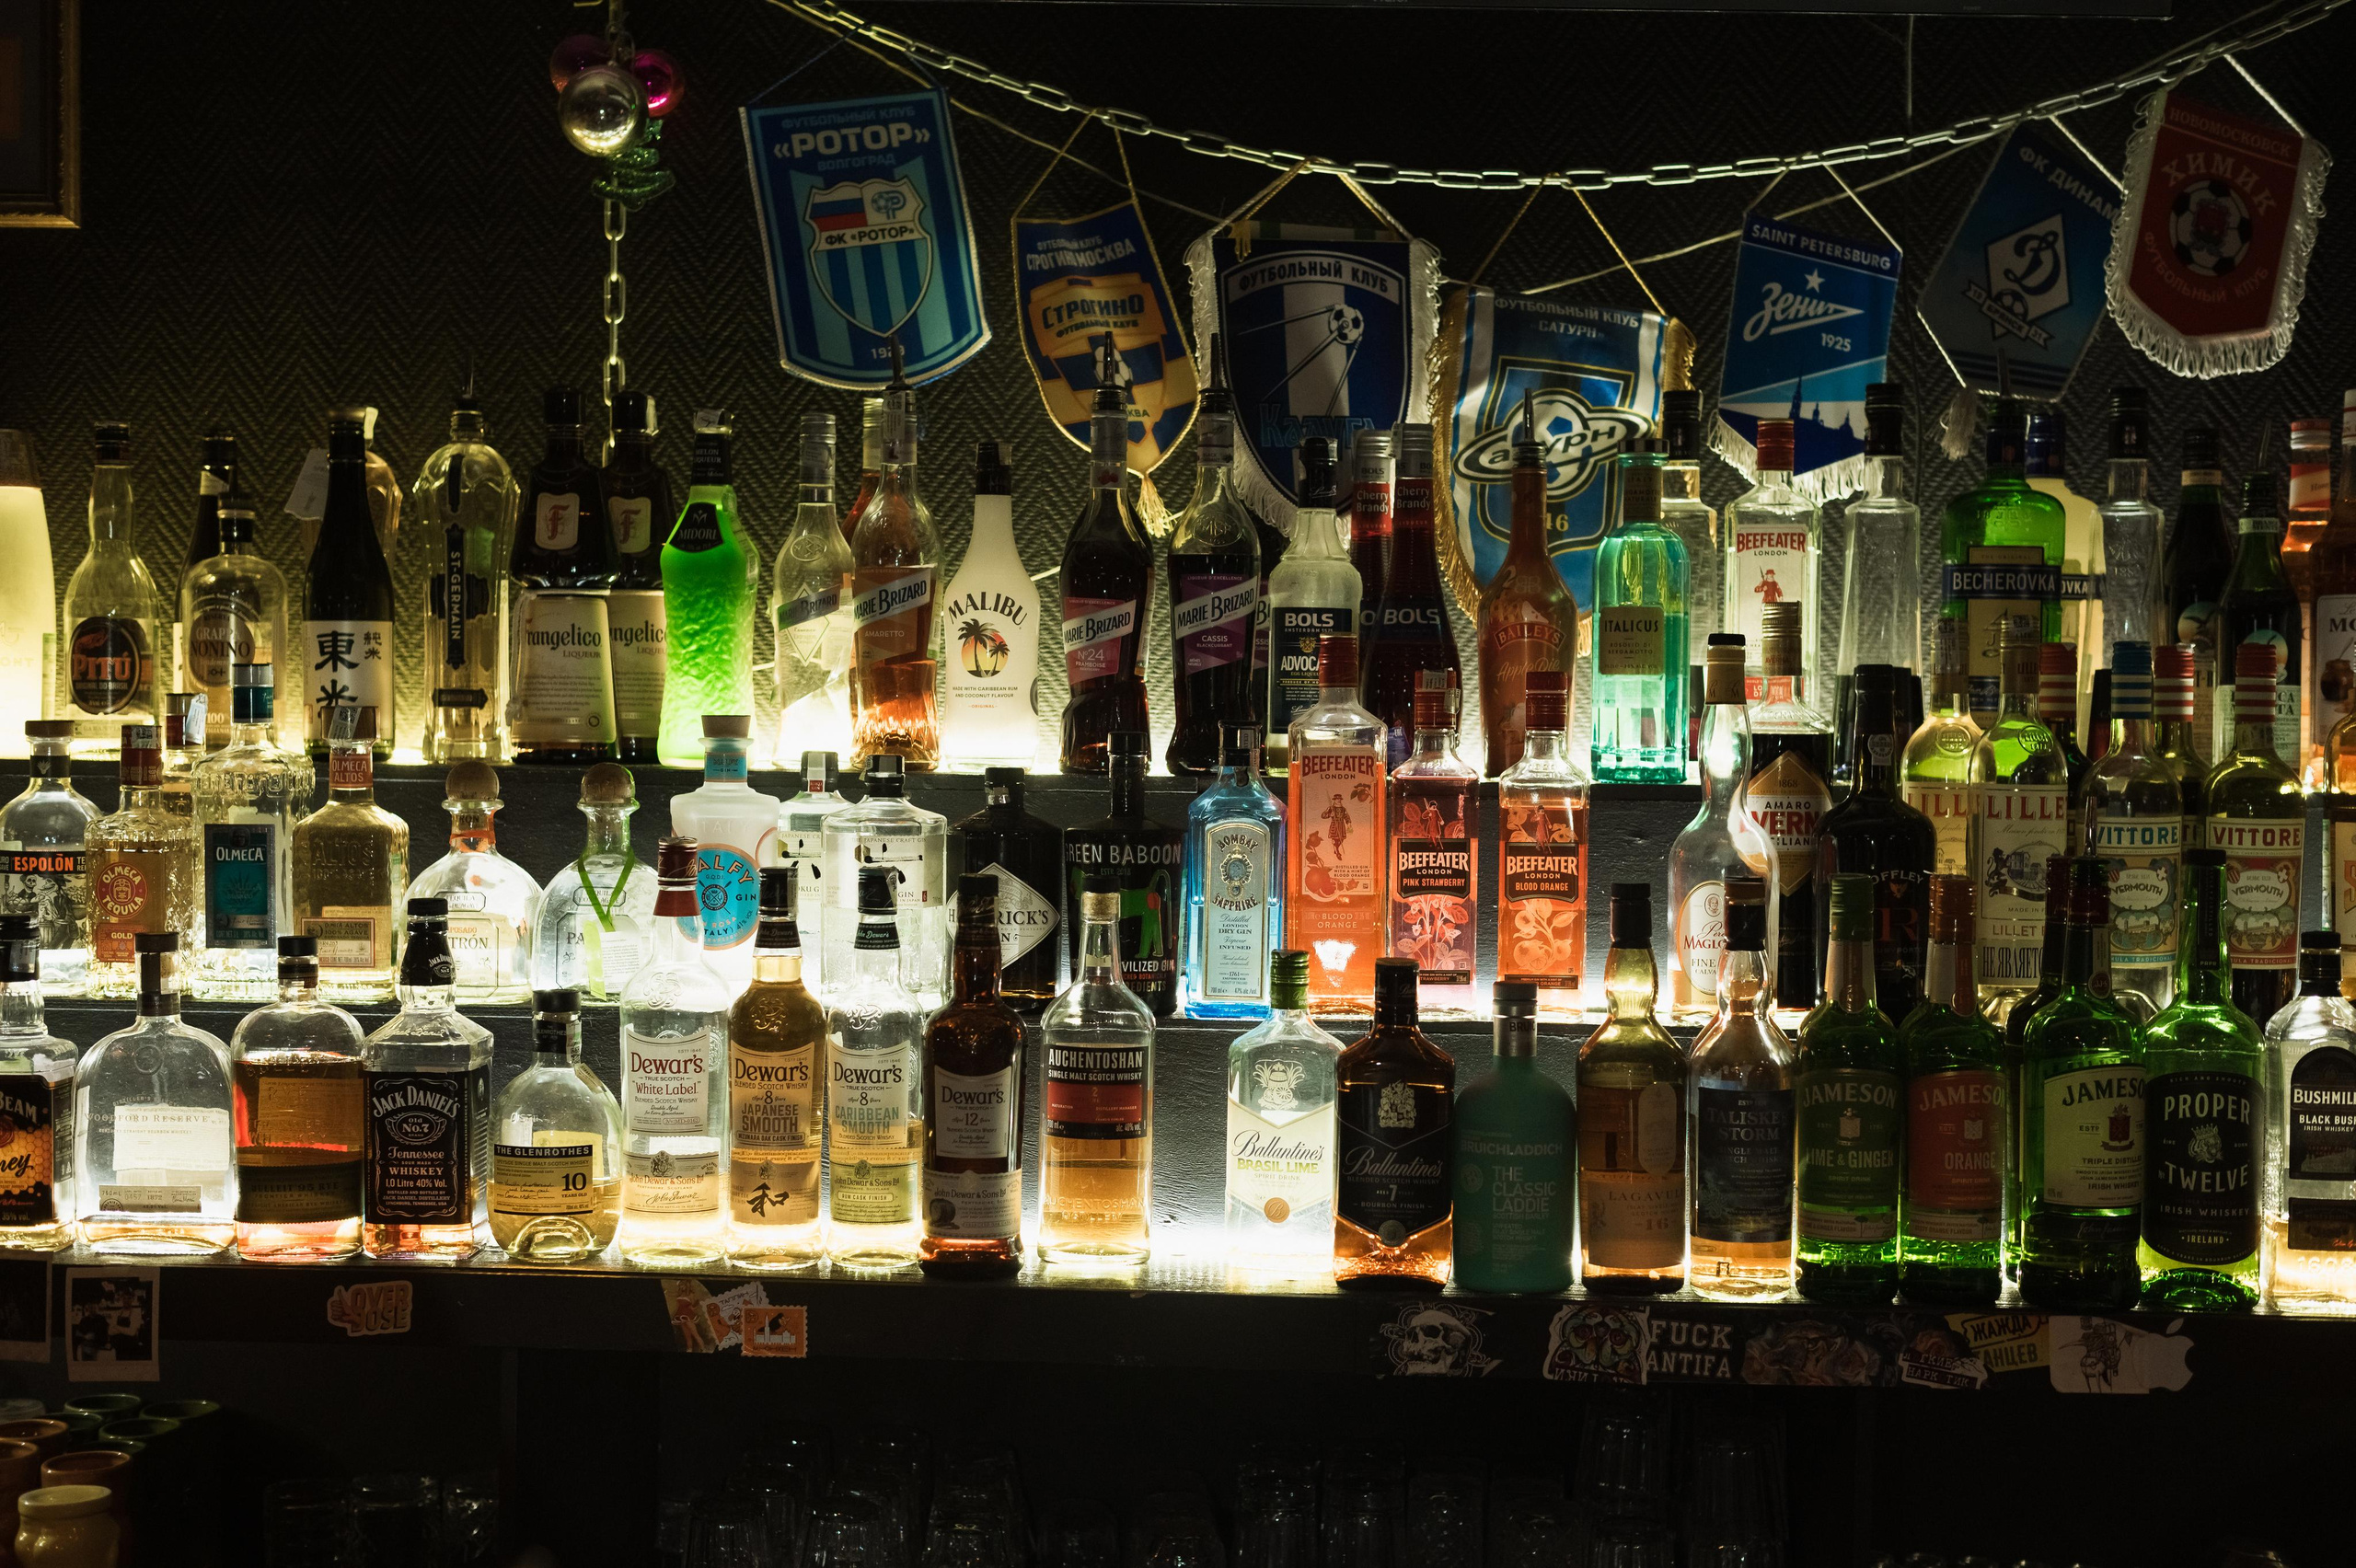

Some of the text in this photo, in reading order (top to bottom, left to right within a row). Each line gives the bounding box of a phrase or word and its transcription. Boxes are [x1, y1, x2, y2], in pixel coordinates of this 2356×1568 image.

[780, 105, 916, 129] ФУТБОЛЬНЫЙ КЛУБ
[773, 122, 931, 159] «РОТОР»
[2169, 108, 2291, 156] НОВОМОСКОВСК
[817, 152, 896, 172] ВОЛГОГРАД
[2018, 145, 2119, 223] ФК ДИНАМ
[2161, 151, 2276, 216] ХИМИК
[825, 225, 916, 246] ФК «РОТОР»
[1750, 222, 1894, 273] SAINT PETERSBURG
[1239, 259, 1390, 294] ФУТБОЛЬНЫЙ КЛУБ
[2143, 231, 2269, 303] ФУТБОЛЬНЫЙ КЛУБ
[1041, 294, 1144, 330] СТРОГИНО
[1494, 296, 1640, 329] ФУТБОЛЬНЫЙ КЛУБ
[1820, 332, 1852, 352] 1925
[1360, 467, 1385, 476] BOLS
[1356, 490, 1390, 504] Cherry
[1396, 485, 1430, 500] Cherry
[1356, 502, 1390, 514] Brandy
[1396, 497, 1431, 511] Brandy
[676, 526, 717, 540] MIDORI
[1737, 532, 1807, 553] BEEFEATER
[1952, 571, 2056, 592] BECHEROVKA
[450, 550, 461, 640] ST-GERMAIN
[853, 580, 928, 621] MARIE BRIZARD
[948, 591, 1028, 626] MALIBU
[1176, 586, 1255, 630] MARIE BRIZARD
[1382, 607, 1441, 626] BOLS
[1085, 611, 1132, 642] BRIZARD
[1284, 612, 1334, 628] BOLS
[1603, 619, 1659, 633] ITALICUS
[864, 629, 905, 639] AMARETTO
[1200, 634, 1230, 643] CASSIS
[1498, 621, 1563, 643] BAILEYS
[190, 642, 251, 659] NONINO
[1496, 663, 1534, 683] Apple
[331, 759, 367, 772] OLMECA
[1301, 755, 1376, 778] BEEFEATER
[334, 771, 364, 783] ALTOS
[1764, 800, 1812, 811] AMARO
[1750, 810, 1827, 836] VERN
[1217, 833, 1260, 852] BOMBAY
[2212, 826, 2301, 847] VITTORE
[215, 846, 265, 862] OLMECA
[1109, 844, 1182, 866] BABOON
[1398, 851, 1470, 871] BEEFEATER
[697, 854, 755, 884] ALFY
[1506, 855, 1578, 875] BEEFEATER
[102, 865, 141, 885] OLMECA
[1403, 877, 1465, 888] PINK STRAWBERRY
[1870, 870, 1924, 885] OFFLEY
[1515, 881, 1569, 892] BLOOD ORANGE
[2111, 883, 2163, 896] VERMOUTH
[2232, 884, 2284, 899] VERMOUTH
[102, 895, 144, 916] TEQUILA
[735, 894, 757, 902] GIN
[1212, 893, 1260, 912] SAPPHIRE
[111, 931, 133, 940] GOLD
[1992, 923, 2038, 938] LILLET
[630, 1051, 704, 1075] Dewar's
[1047, 1048, 1144, 1071] AUCHENTOSHAN
[734, 1057, 809, 1083] Dewar's
[834, 1060, 903, 1084] Dewar's
[1047, 1069, 1143, 1081] SINGLE MALT SCOTCH WHISKY
[372, 1085, 461, 1119] JACK DANIEL'S
[941, 1086, 1005, 1105] Dewar's
[1803, 1082, 1897, 1110] JAMESON
[85, 1112, 211, 1124] WOODFORD RESERVE
[741, 1102, 799, 1117] JAPANESE
[835, 1104, 899, 1121] CARIBBEAN
[2164, 1091, 2251, 1126] PROPER
[401, 1123, 430, 1133] No.7
[742, 1115, 799, 1134] SMOOTH
[841, 1120, 891, 1135] SMOOTH
[964, 1112, 979, 1126] 12
[2299, 1113, 2331, 1124] BLACK
[1718, 1127, 1781, 1142] STORM
[387, 1146, 445, 1159] Tennessee
[496, 1146, 590, 1157] THE GLENROTHES
[1233, 1129, 1325, 1162] Ballantine's
[1460, 1140, 1564, 1156] BRUICHLADDICH
[1236, 1158, 1321, 1174] BRASIL LIME
[1344, 1147, 1443, 1178] Ballantine's
[1806, 1148, 1834, 1168] LIME
[1837, 1150, 1845, 1167] &
[1847, 1148, 1894, 1169] GINGER
[1945, 1152, 1996, 1170] ORANGE
[388, 1166, 445, 1176] WHISKEY
[1492, 1166, 1524, 1182] THE
[2164, 1159, 2249, 1193] TWELVE
[318, 1182, 340, 1191] RYE
[560, 1171, 587, 1192] 10
[1492, 1181, 1557, 1197] CLASSIC
[746, 1181, 791, 1217] 和
[1360, 1201, 1426, 1210] BOURBON FINISH
[1492, 1197, 1551, 1213] LADDIE
[2159, 1205, 2251, 1217] IRISH WHISKEY
[2186, 1233, 2225, 1244] IRELAND
[351, 1286, 410, 1307] OVER
[1649, 1319, 1734, 1351] FUCK
[1969, 1315, 2032, 1343] ЖАЖДА
[1646, 1353, 1733, 1379] ANTIFA
